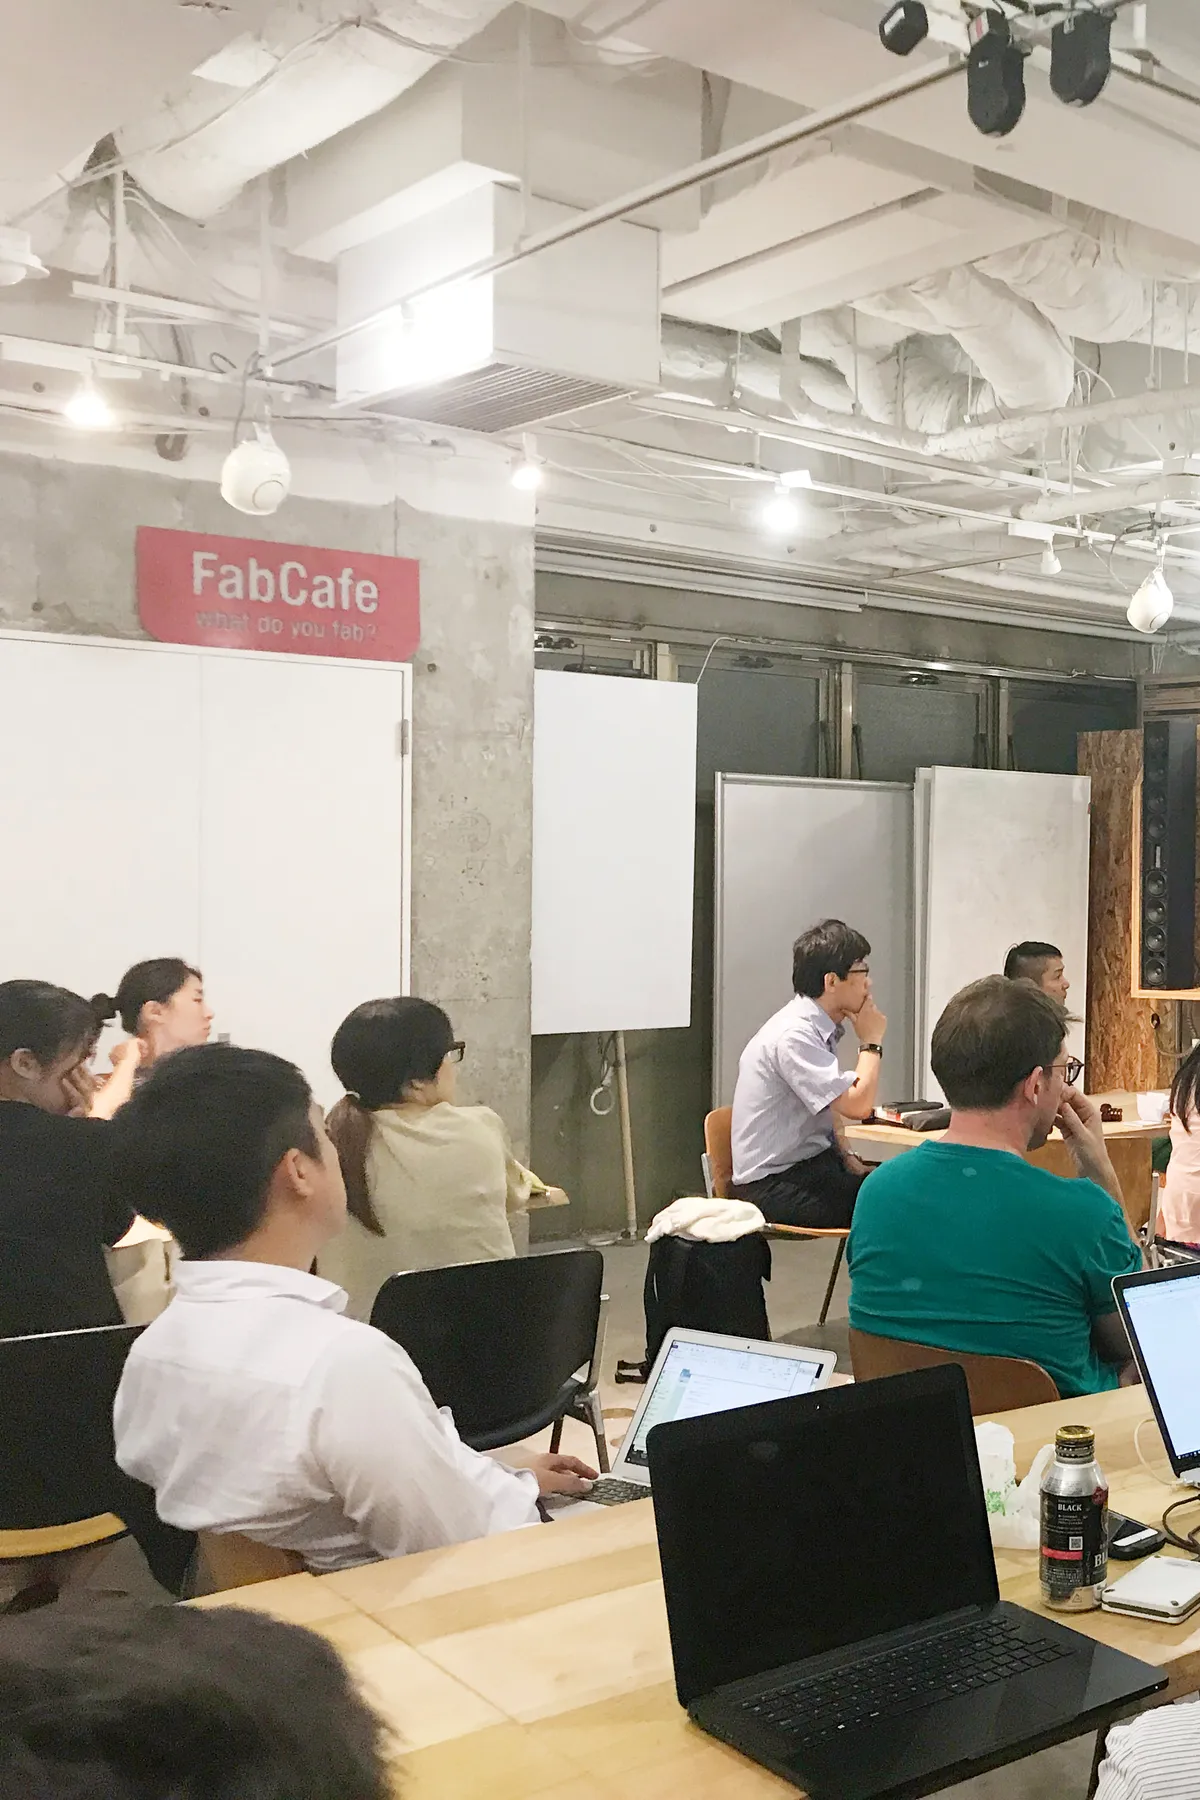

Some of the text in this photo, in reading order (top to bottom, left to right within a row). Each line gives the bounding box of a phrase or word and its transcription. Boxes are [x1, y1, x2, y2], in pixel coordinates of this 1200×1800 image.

[192, 551, 379, 613] FabCafe
[258, 615, 284, 635] do
[291, 620, 326, 640] you
[1057, 1503, 1082, 1512] BLACK
